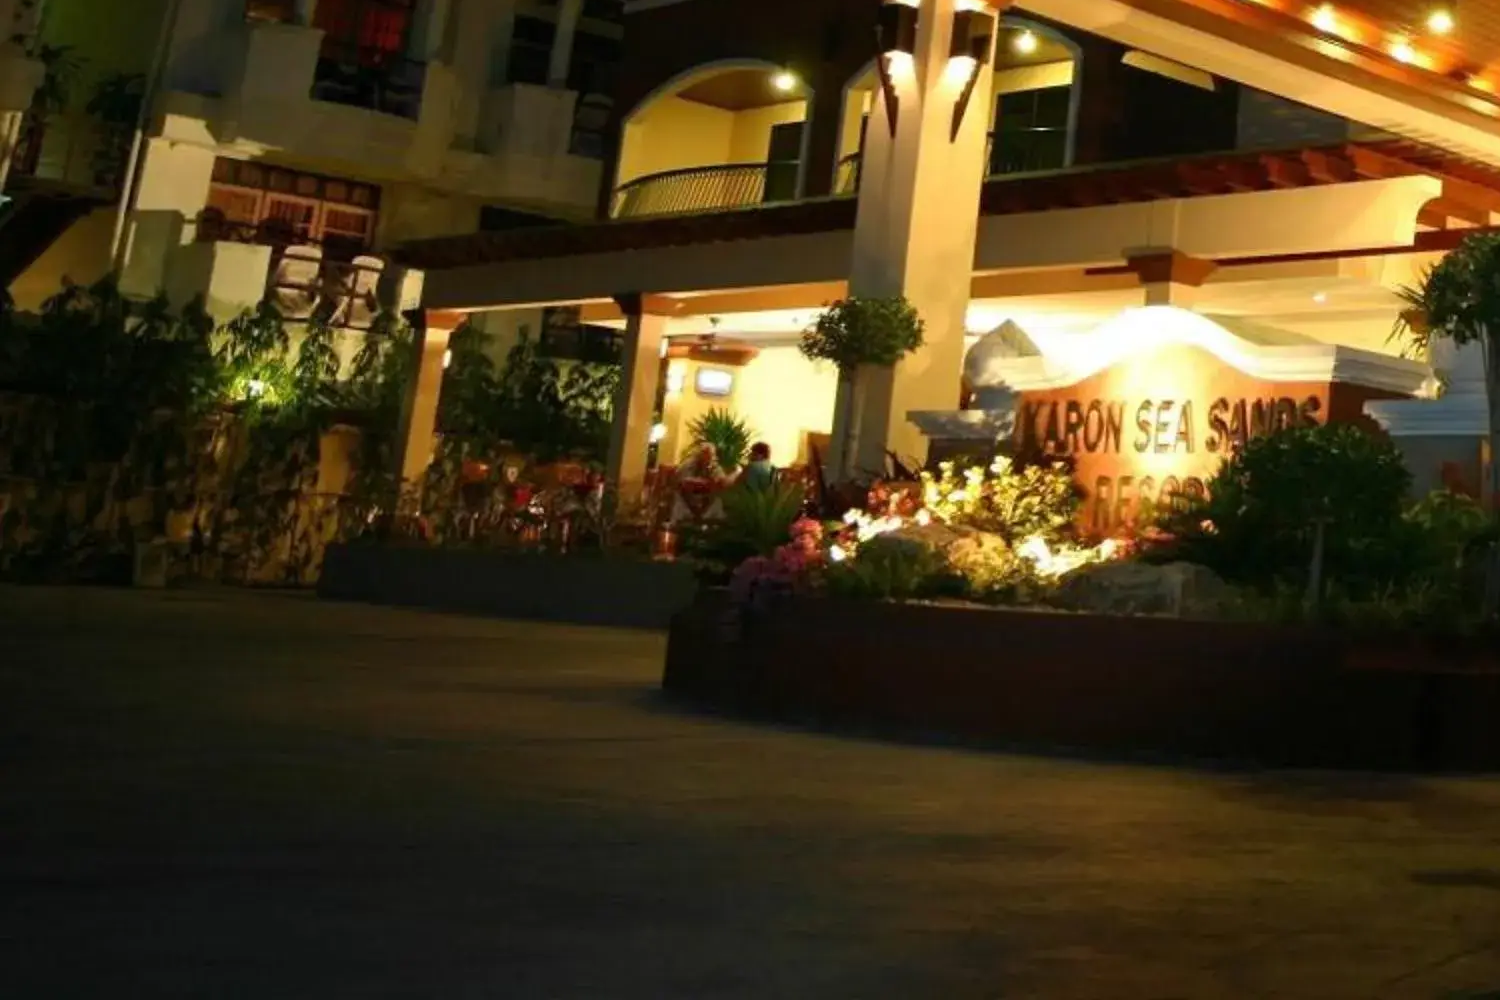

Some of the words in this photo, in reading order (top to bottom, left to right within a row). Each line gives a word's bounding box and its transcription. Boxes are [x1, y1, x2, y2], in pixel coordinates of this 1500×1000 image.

[1021, 398, 1125, 454] KARON
[1134, 398, 1195, 454] SEA
[1205, 395, 1322, 454] SANDS
[1092, 475, 1209, 531] RESOR
